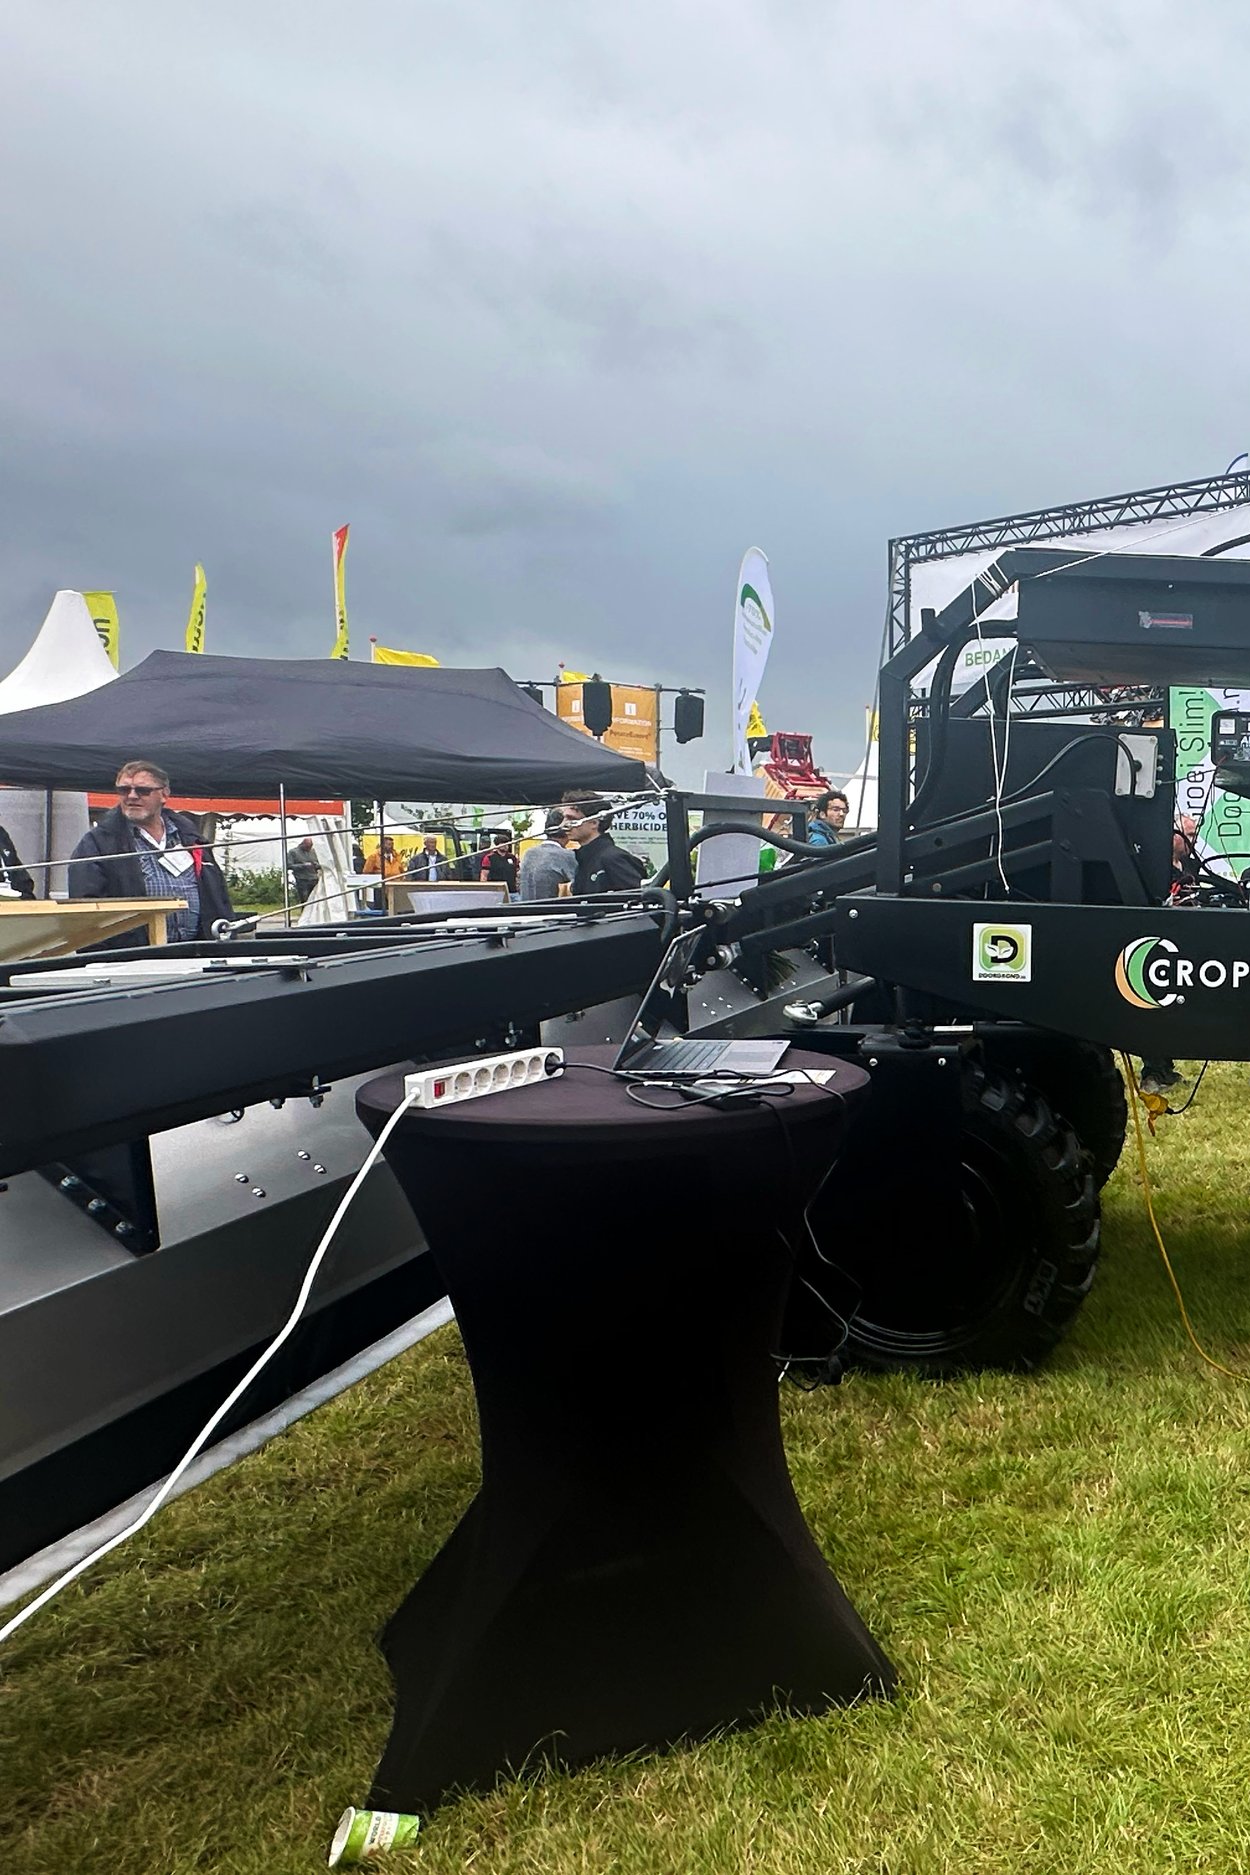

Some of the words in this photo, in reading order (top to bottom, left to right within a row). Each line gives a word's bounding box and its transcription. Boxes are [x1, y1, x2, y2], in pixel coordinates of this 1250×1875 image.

[965, 647, 1012, 668] BEDA
[1179, 690, 1205, 752] Slim!
[1180, 764, 1205, 817] roei
[632, 811, 656, 821] 70%
